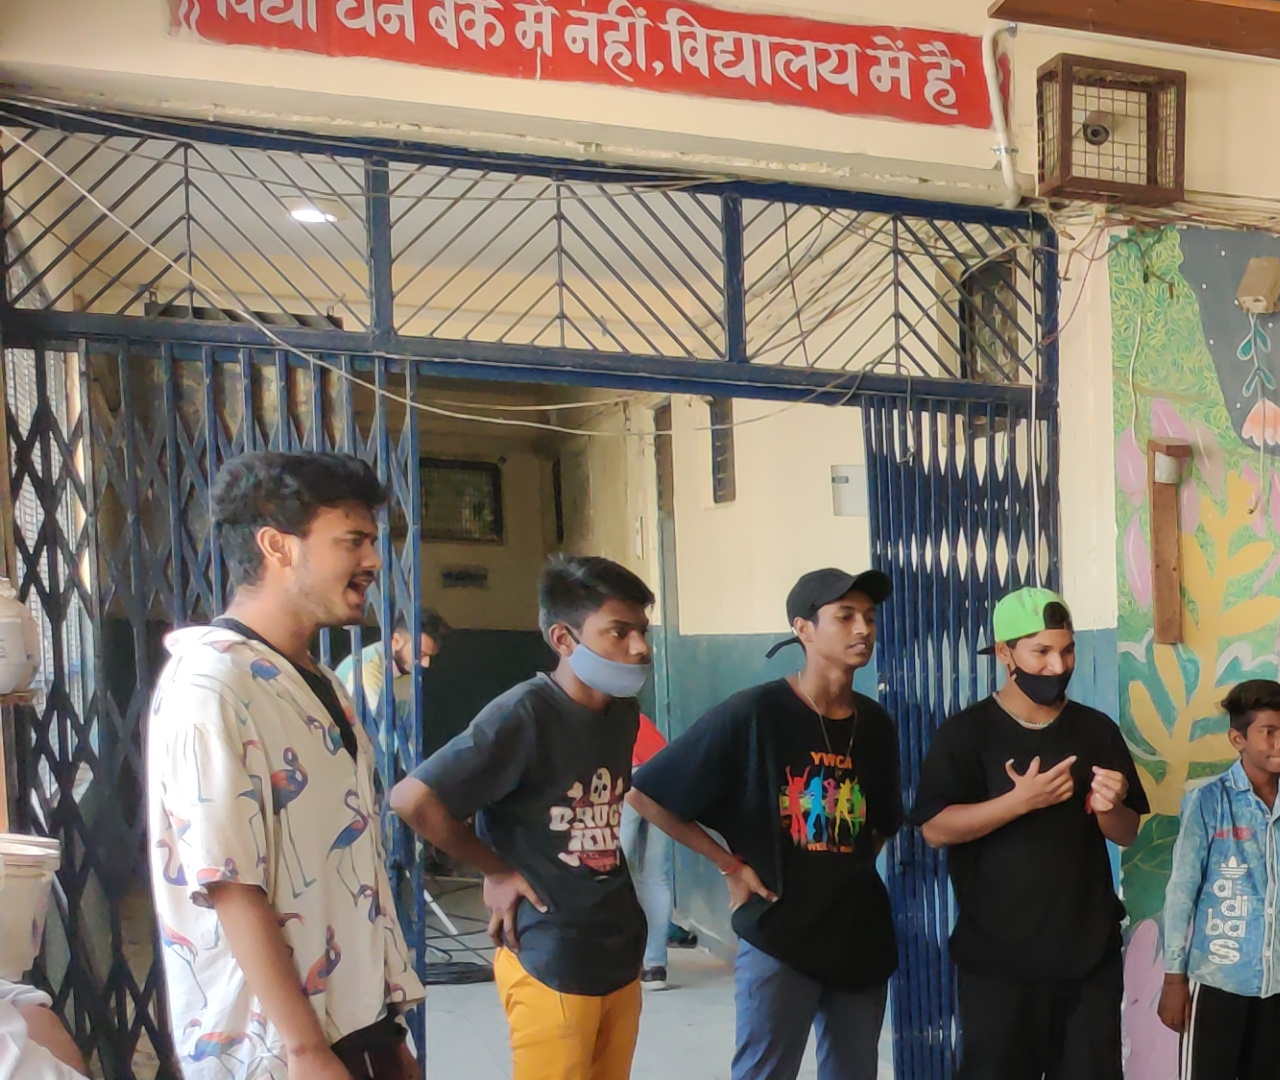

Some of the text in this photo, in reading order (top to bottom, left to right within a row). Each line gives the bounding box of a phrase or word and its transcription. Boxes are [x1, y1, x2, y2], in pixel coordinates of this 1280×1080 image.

[428, 0, 506, 50] बक
[658, 8, 863, 97] विद्यालय
[865, 35, 917, 100] में
[917, 40, 967, 115] है
[810, 751, 853, 770] YWCA
